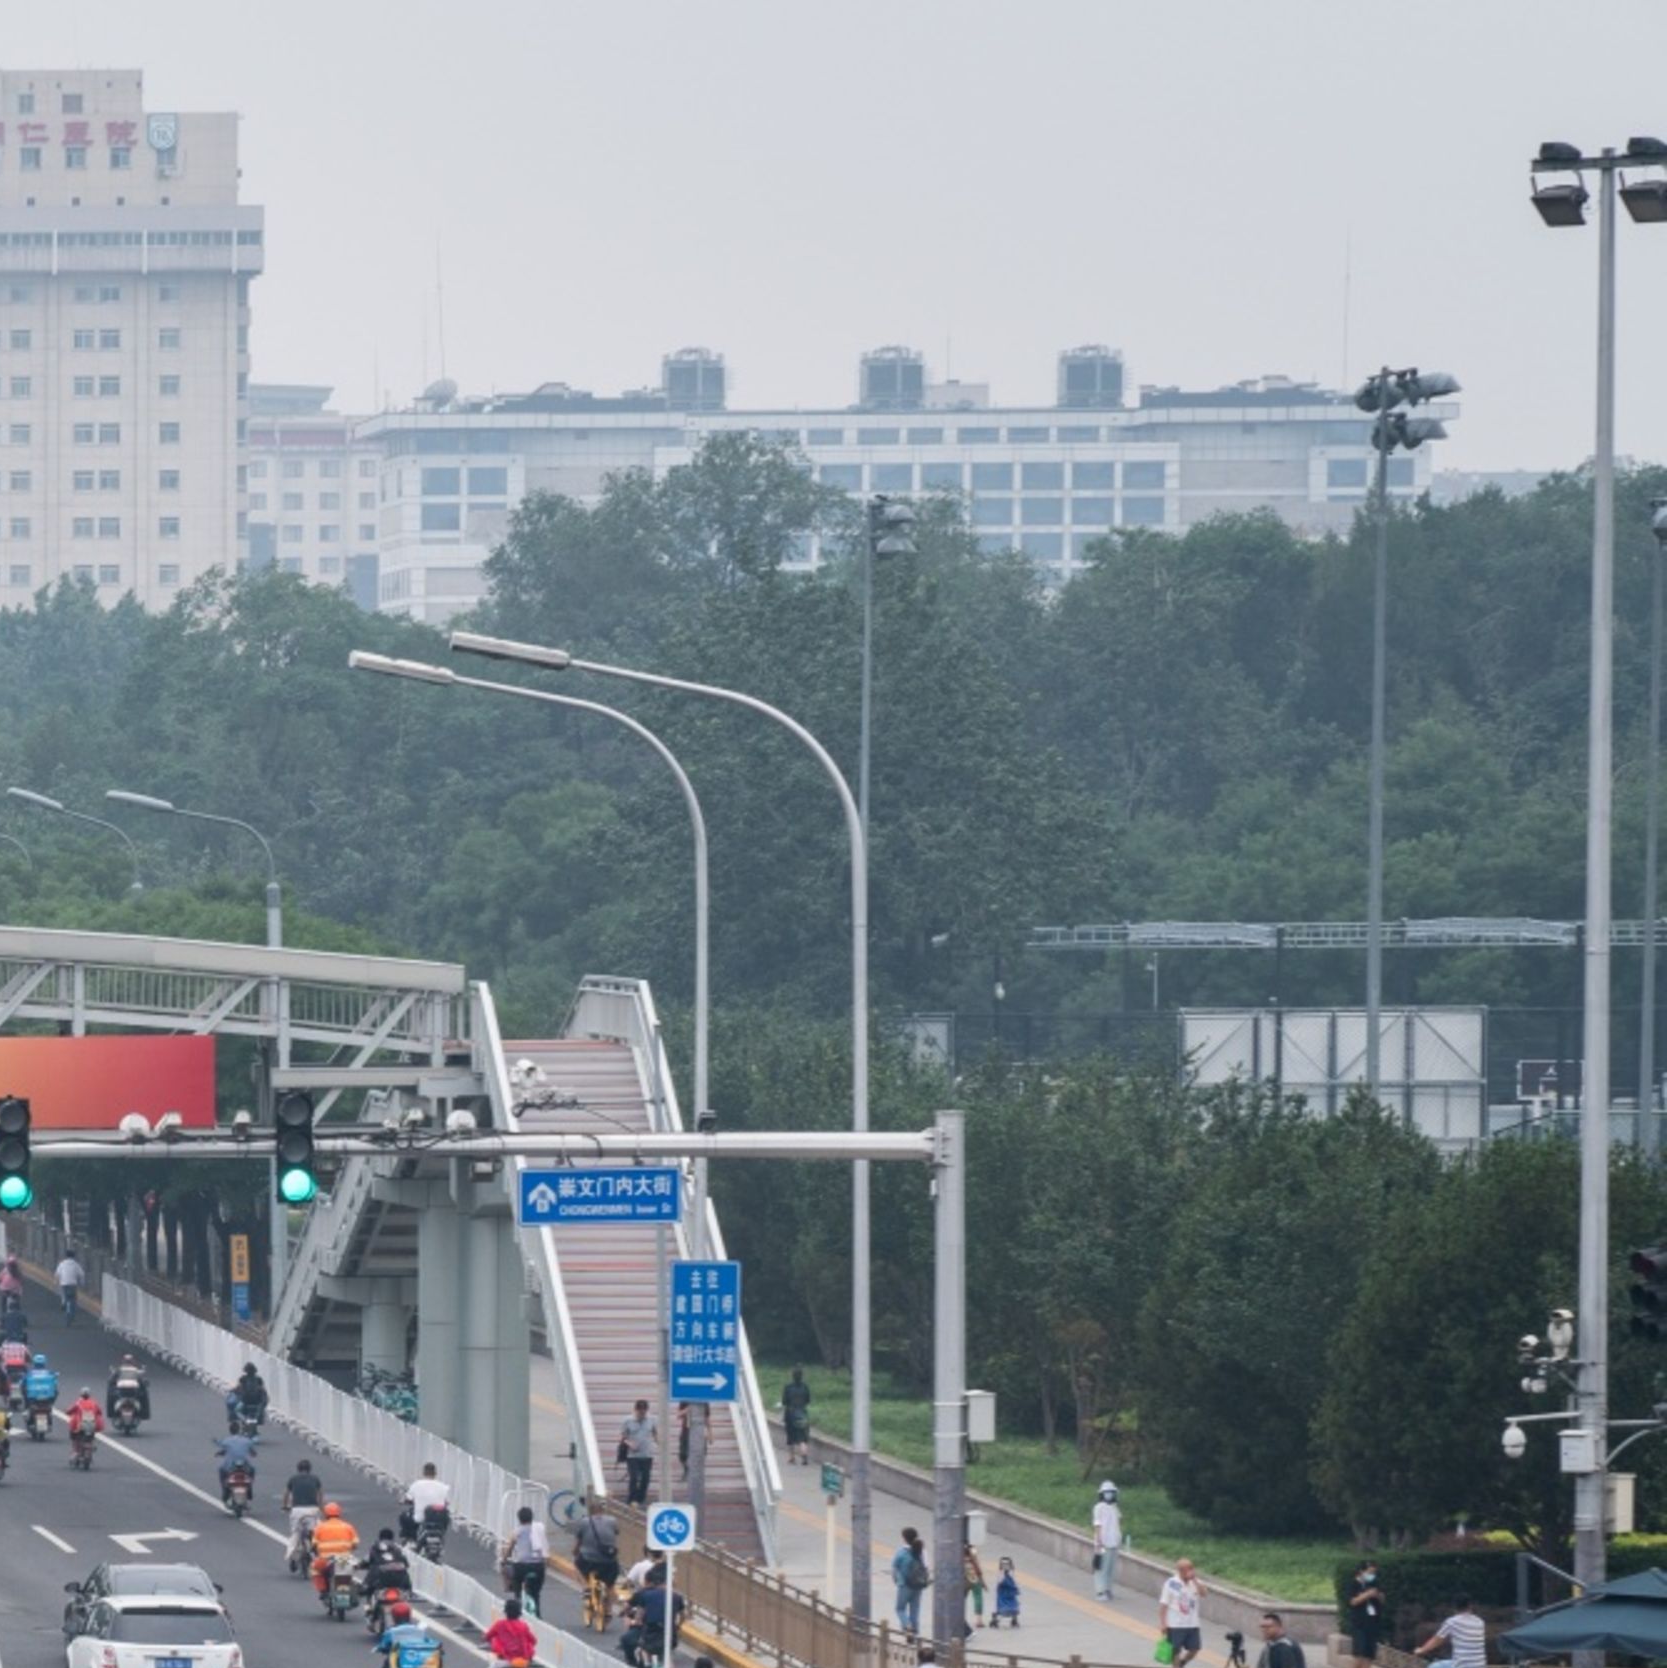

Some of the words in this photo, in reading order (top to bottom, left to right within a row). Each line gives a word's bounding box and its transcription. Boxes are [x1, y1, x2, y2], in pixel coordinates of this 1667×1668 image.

[558, 1174, 672, 1198] 崇文门内大街
